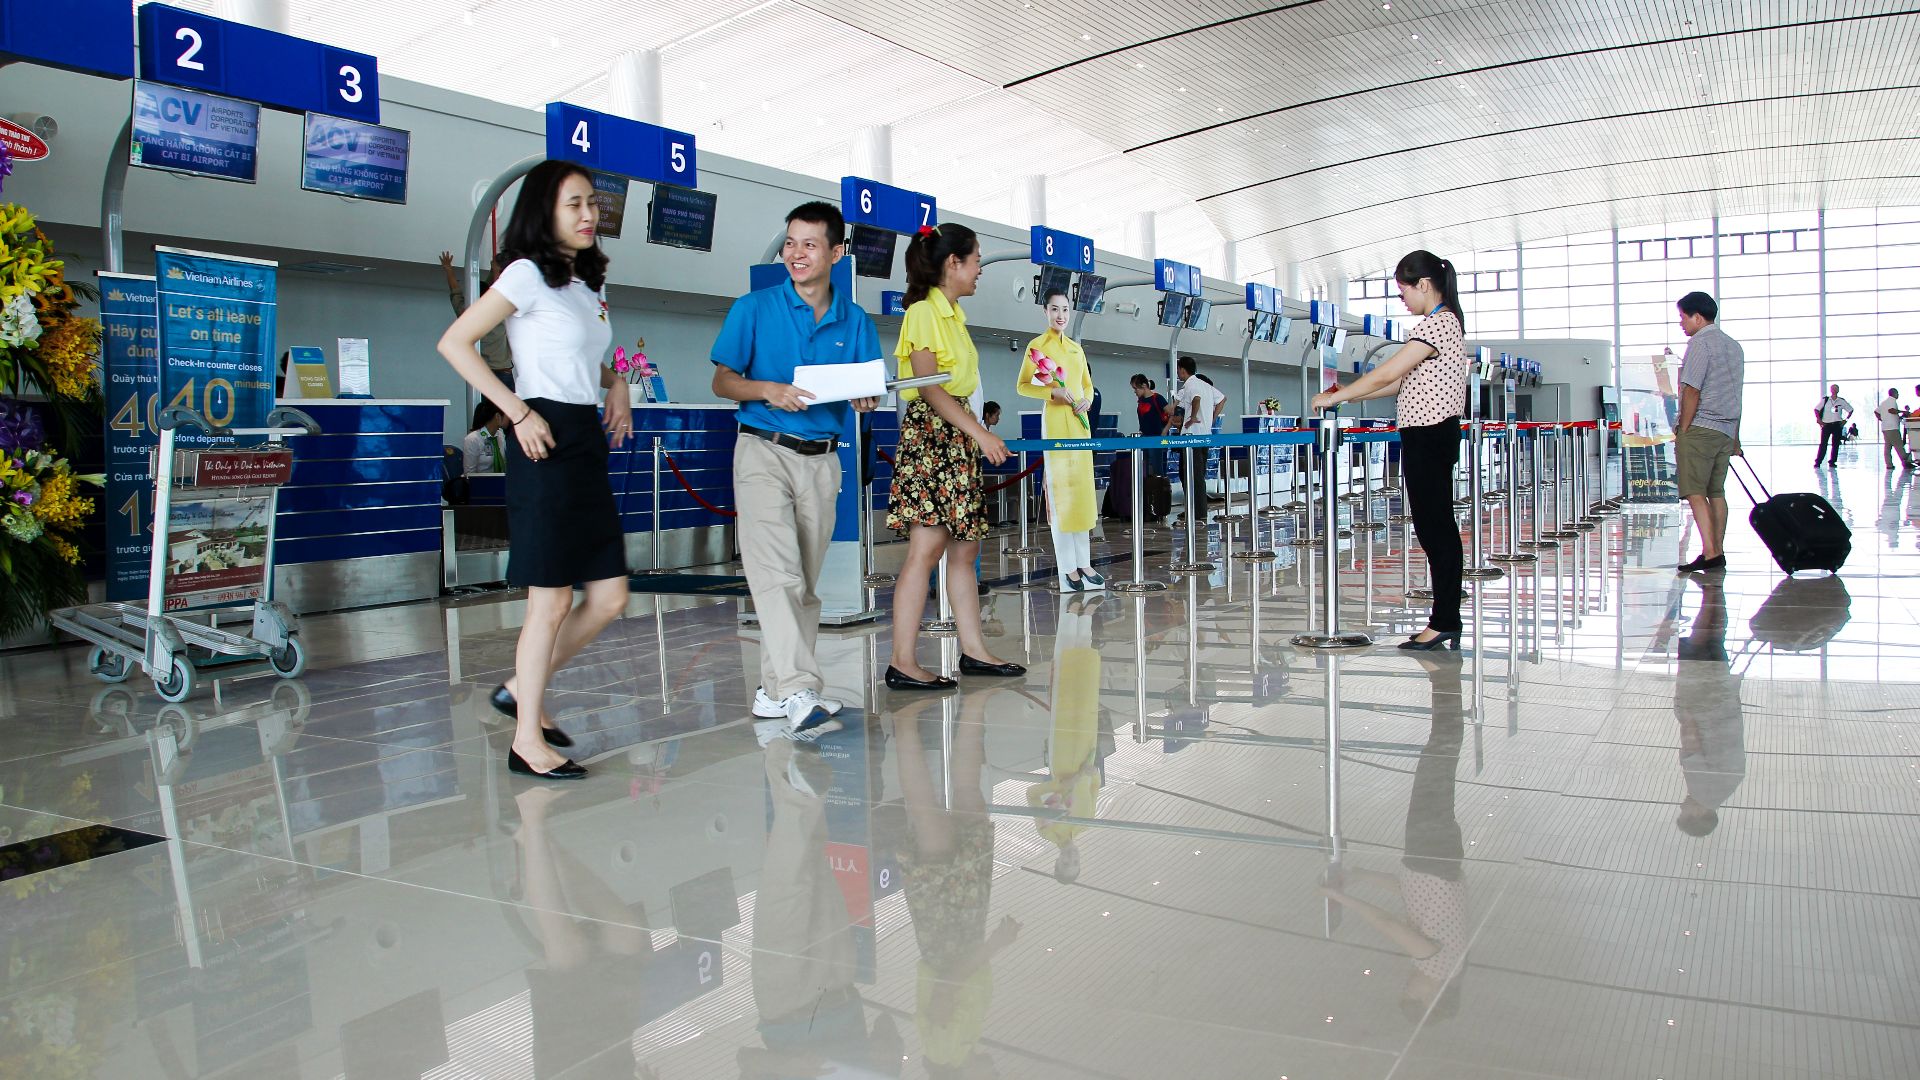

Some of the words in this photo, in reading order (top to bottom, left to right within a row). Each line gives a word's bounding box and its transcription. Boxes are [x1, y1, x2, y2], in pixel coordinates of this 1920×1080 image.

[174, 27, 205, 71] 2
[338, 65, 363, 103] 3
[139, 92, 202, 126] ACV
[211, 107, 244, 118] AIRPORTS
[210, 115, 257, 128] CORPORATION
[221, 125, 249, 135] VIETNAM
[308, 124, 359, 152] ACV
[571, 120, 591, 153] 4
[162, 150, 179, 160] CAT
[181, 153, 191, 161] BI
[192, 156, 230, 167] AIRPORT
[367, 148, 376, 156] OF
[670, 142, 687, 173] 5
[328, 174, 342, 183] CAT
[353, 178, 384, 191] AIRPORT
[859, 188, 873, 215] 6
[919, 202, 932, 227] 7
[1046, 236, 1054, 256] 8
[1083, 245, 1091, 265] 9
[184, 270, 221, 284] Vietnam
[222, 275, 254, 288] Airlines
[1164, 266, 1175, 284] 10
[1192, 273, 1200, 290] 11
[1255, 289, 1262, 305] 12
[169, 303, 204, 320] Let's
[207, 308, 224, 322] all
[226, 310, 262, 326] leave
[140, 325, 159, 339] cù
[191, 329, 208, 341] on
[212, 329, 241, 344] time
[206, 361, 237, 370] counter
[238, 362, 263, 372] closes
[166, 376, 235, 428] 40
[234, 380, 272, 390] minutes
[174, 433, 196, 442] efore
[196, 434, 235, 445] departure
[837, 441, 850, 449] Plus
